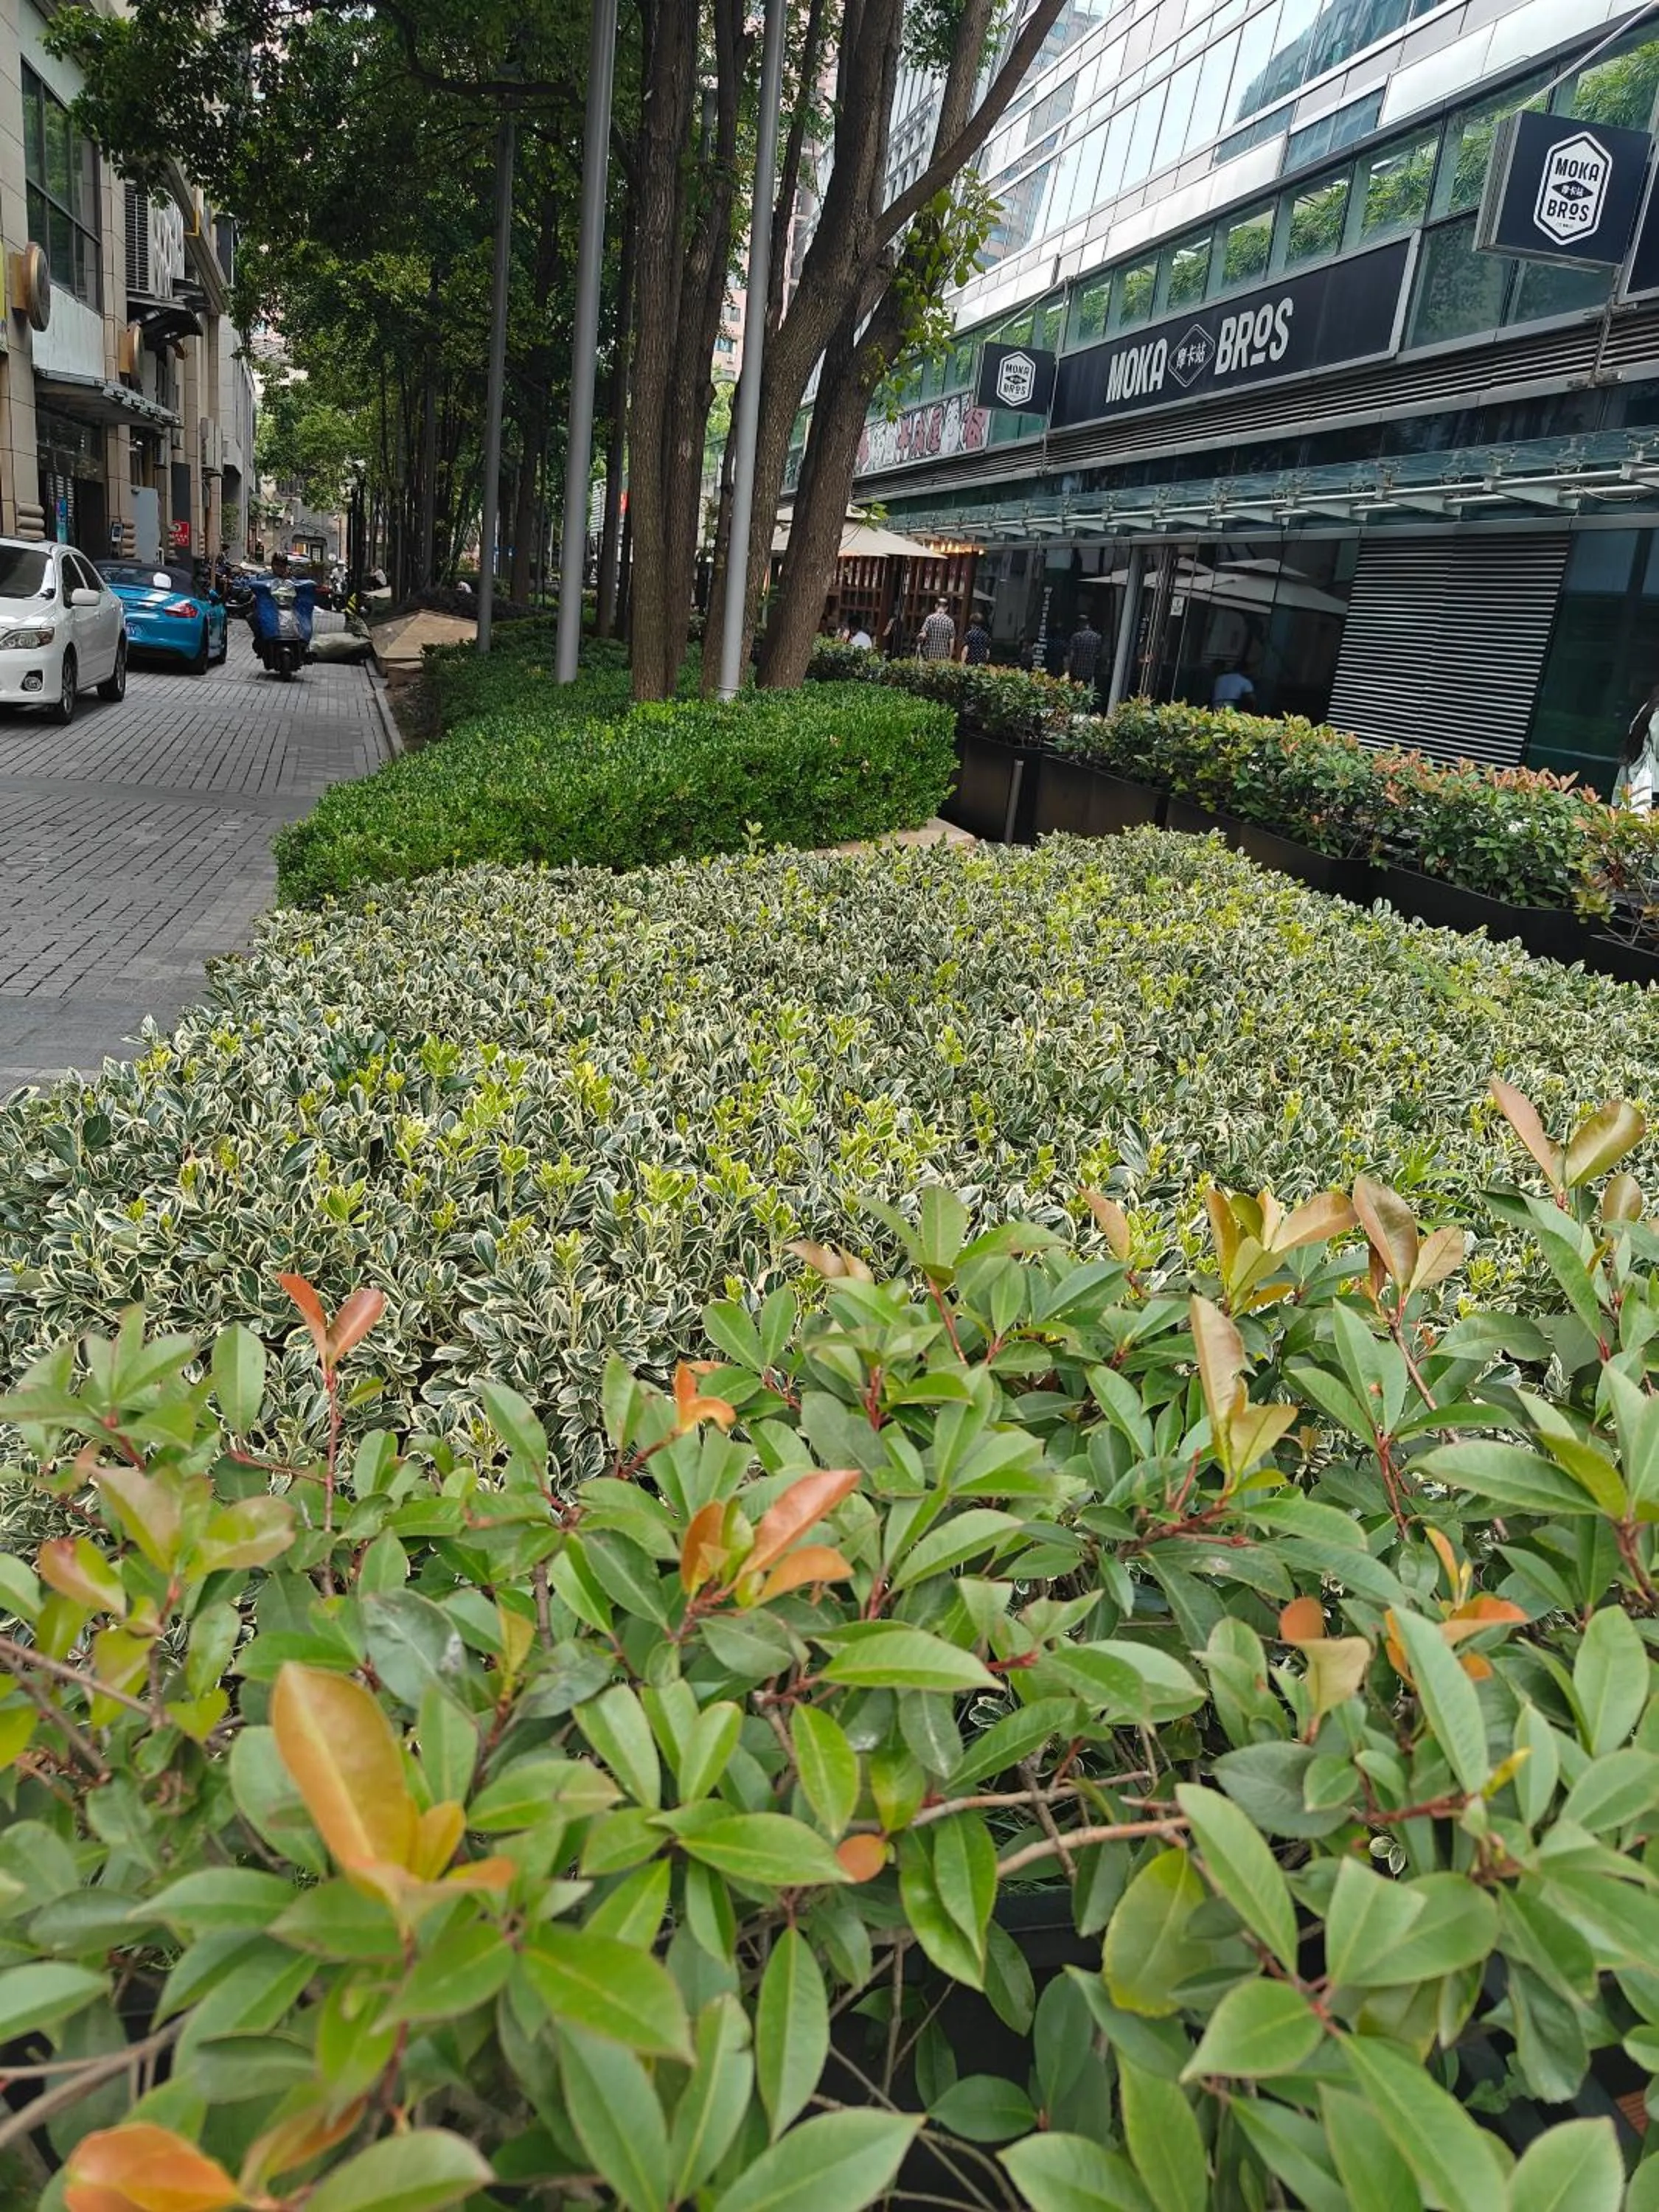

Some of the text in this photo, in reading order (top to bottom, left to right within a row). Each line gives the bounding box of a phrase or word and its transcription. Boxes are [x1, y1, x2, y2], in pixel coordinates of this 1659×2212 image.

[1555, 157, 1599, 182] MOKA
[1547, 198, 1590, 222] BROS
[1105, 338, 1168, 403] MOKA
[1214, 297, 1294, 375] BROS
[1006, 364, 1030, 376] MOKA
[1004, 383, 1026, 395] BROS
